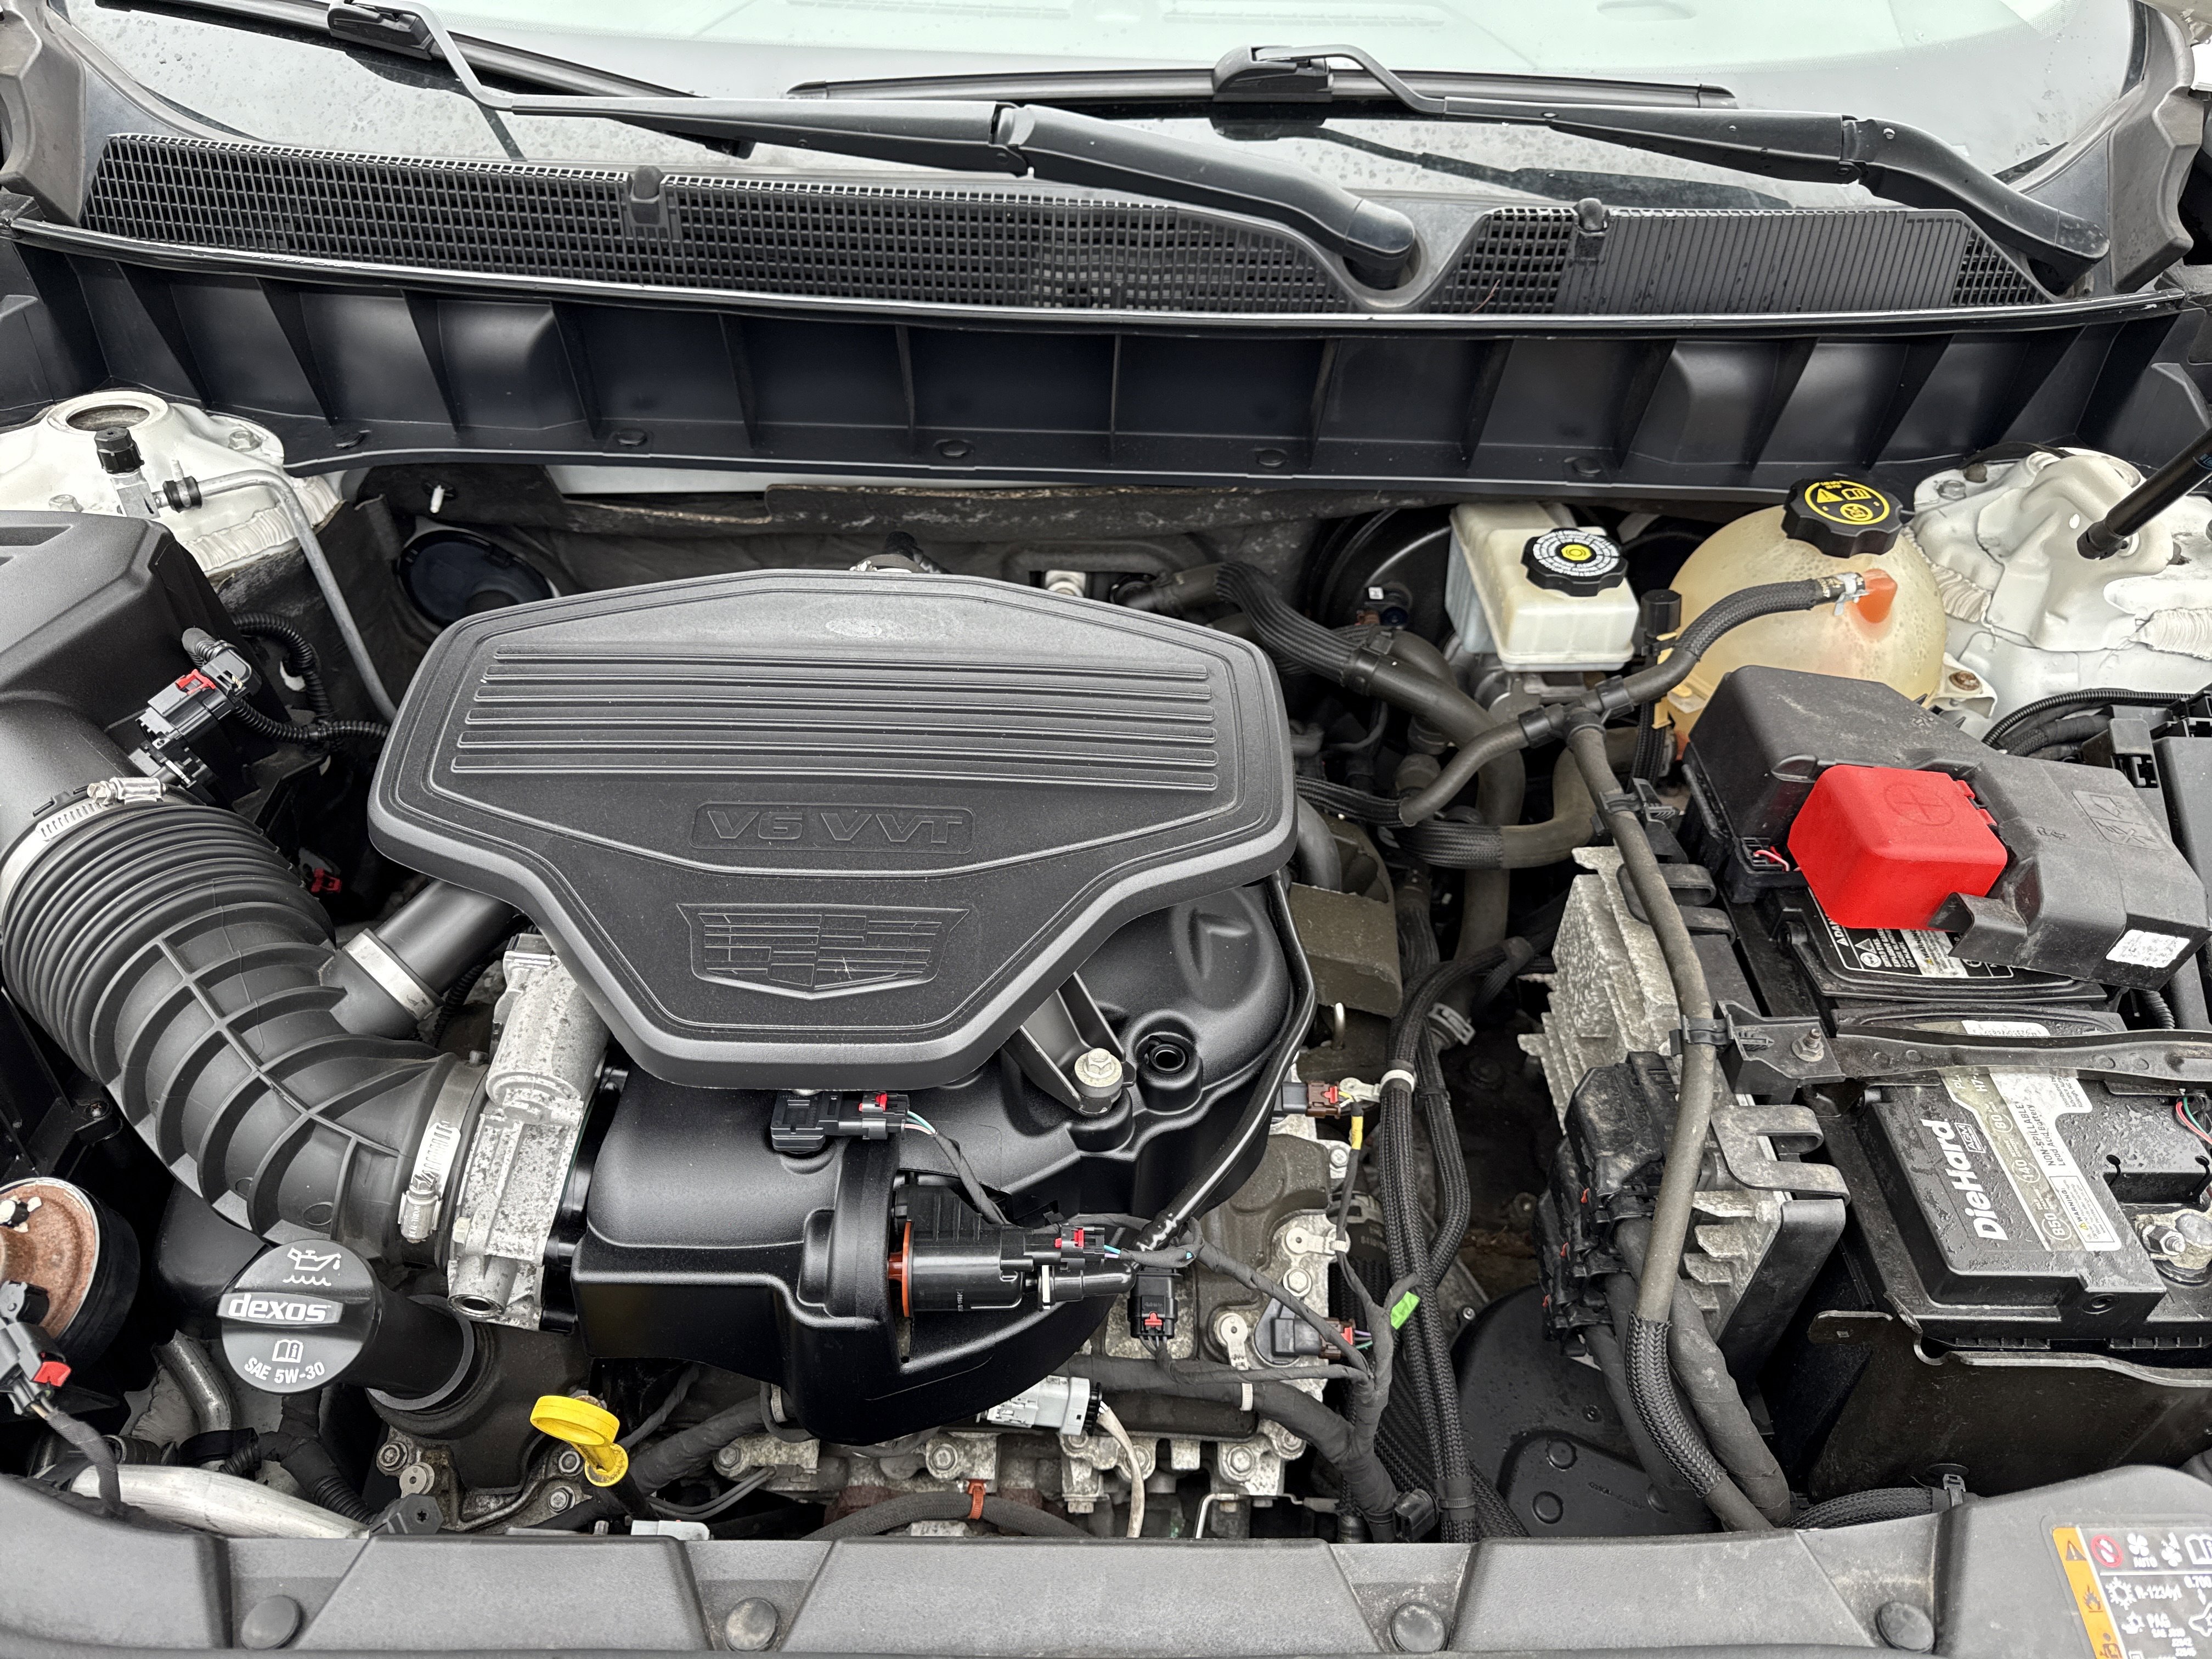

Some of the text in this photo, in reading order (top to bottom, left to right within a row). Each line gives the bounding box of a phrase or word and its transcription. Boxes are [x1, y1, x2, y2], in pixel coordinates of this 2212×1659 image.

[707, 810, 962, 843] V6 VVT
[1991, 1114, 2006, 1128] 80
[1958, 1125, 1975, 1149] AGM
[2015, 1104, 2056, 1166] NON-SPILLABLE
[2026, 1104, 2066, 1166] Lead Acid Battery
[1921, 1119, 2008, 1240] DieHard
[2015, 1159, 2034, 1179] 140
[2044, 1212, 2065, 1235] 850
[228, 1294, 326, 1322] dexos
[244, 1357, 325, 1384] SAE 5W-30
[2133, 1556, 2158, 1568] AUTO
[2147, 1613, 2171, 1628] PAG
